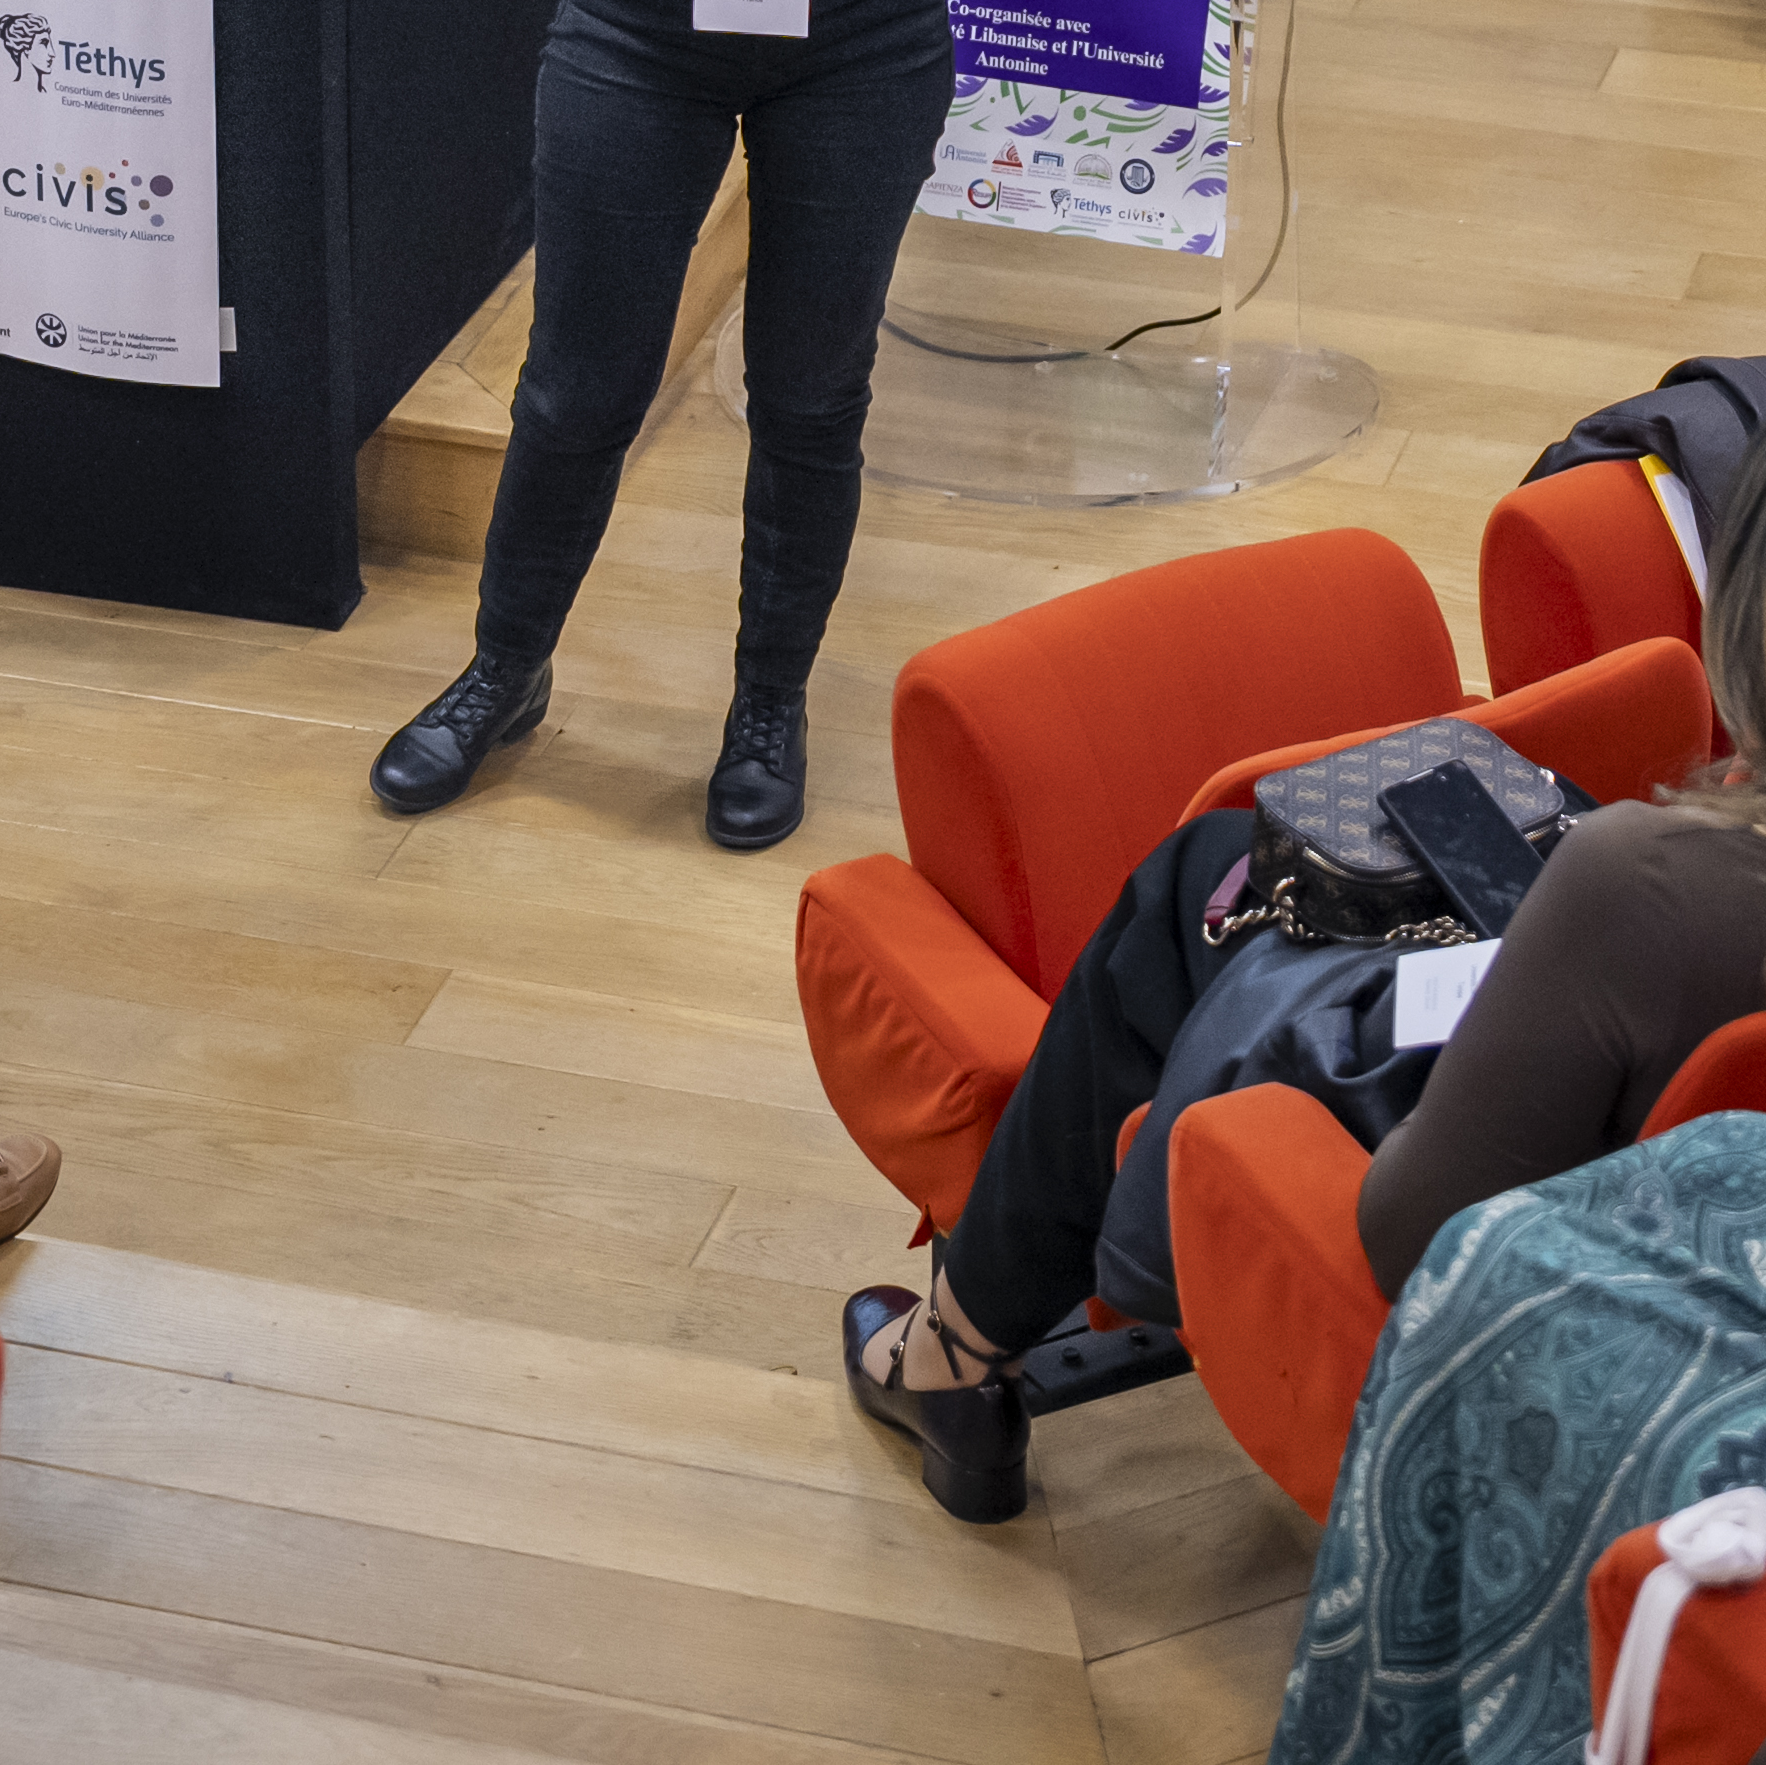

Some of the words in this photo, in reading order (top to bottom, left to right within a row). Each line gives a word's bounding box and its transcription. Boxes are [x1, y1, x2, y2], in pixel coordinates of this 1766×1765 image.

[1056, 15, 1091, 34] avec
[970, 25, 1047, 52] Libanaise
[1052, 39, 1067, 55] et
[59, 41, 166, 88] Téthys
[975, 51, 1048, 76] Antonine
[54, 82, 102, 98] Consortium
[105, 89, 120, 100] des
[123, 90, 172, 105] Universités
[62, 96, 164, 117] Euro-Méditerranéennes
[1073, 198, 1112, 216] Téthys
[49, 215, 72, 231] Civic
[75, 222, 127, 240] University
[130, 229, 174, 243] Alliance
